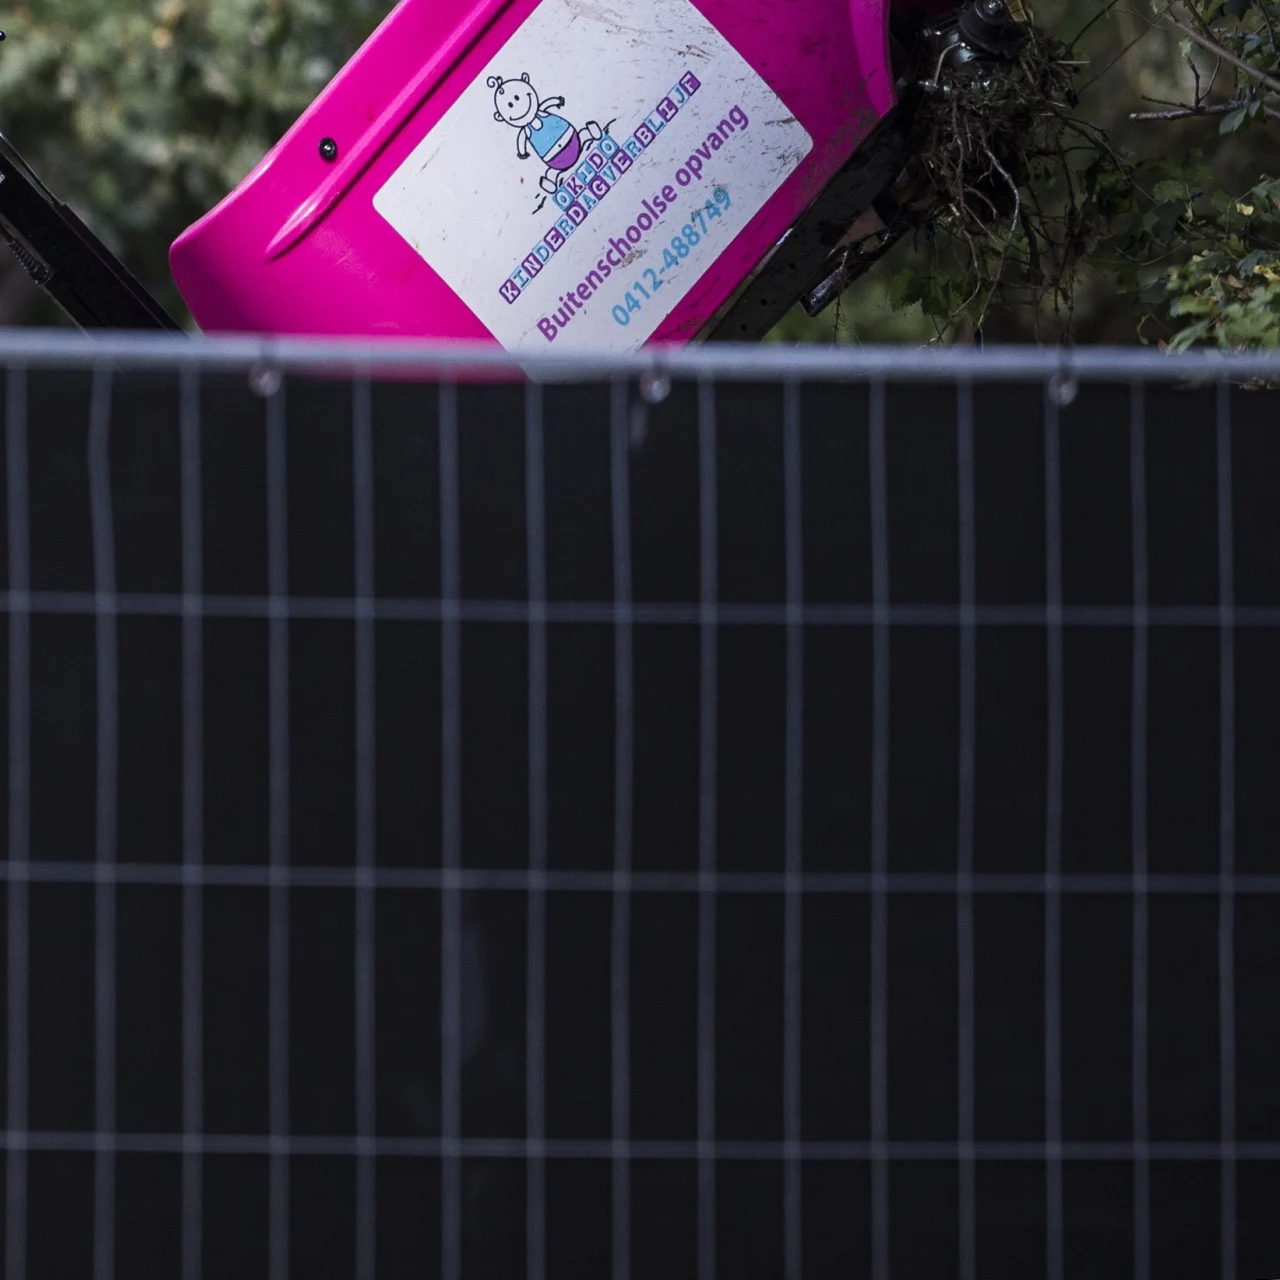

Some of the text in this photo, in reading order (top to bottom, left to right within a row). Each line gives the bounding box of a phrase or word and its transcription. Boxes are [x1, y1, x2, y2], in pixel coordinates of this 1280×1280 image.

[499, 71, 701, 304] KINDERDAGVERBLIJF
[536, 104, 749, 342] Buitenschoolse opvang
[553, 136, 619, 210] OKIDO
[612, 187, 731, 327] 0412-488749
